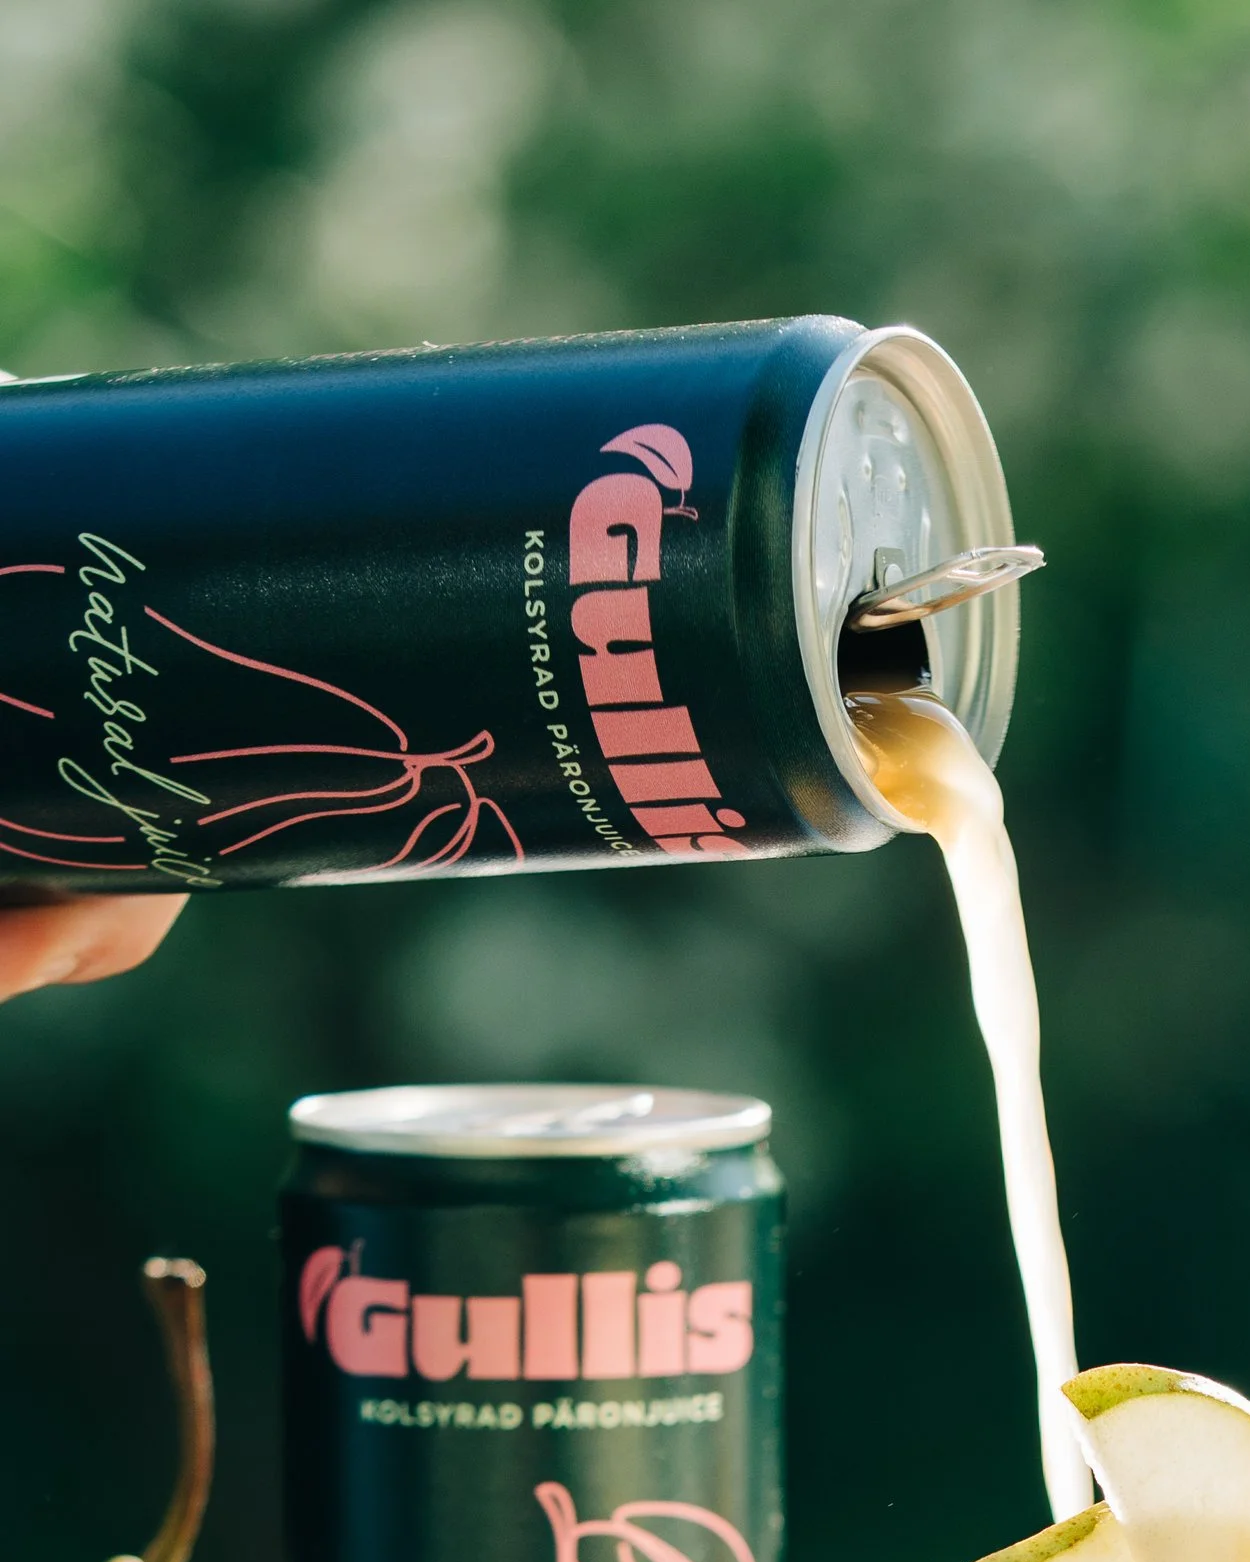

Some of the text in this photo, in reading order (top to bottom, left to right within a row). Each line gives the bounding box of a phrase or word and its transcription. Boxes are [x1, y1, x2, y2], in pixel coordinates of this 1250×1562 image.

[68, 532, 211, 805] natural
[523, 530, 642, 858] KOLSYRAD PÄRONJUICE
[326, 1260, 754, 1381] Gullis
[360, 1395, 724, 1430] KOLSYRAD PÄRONJUICE
